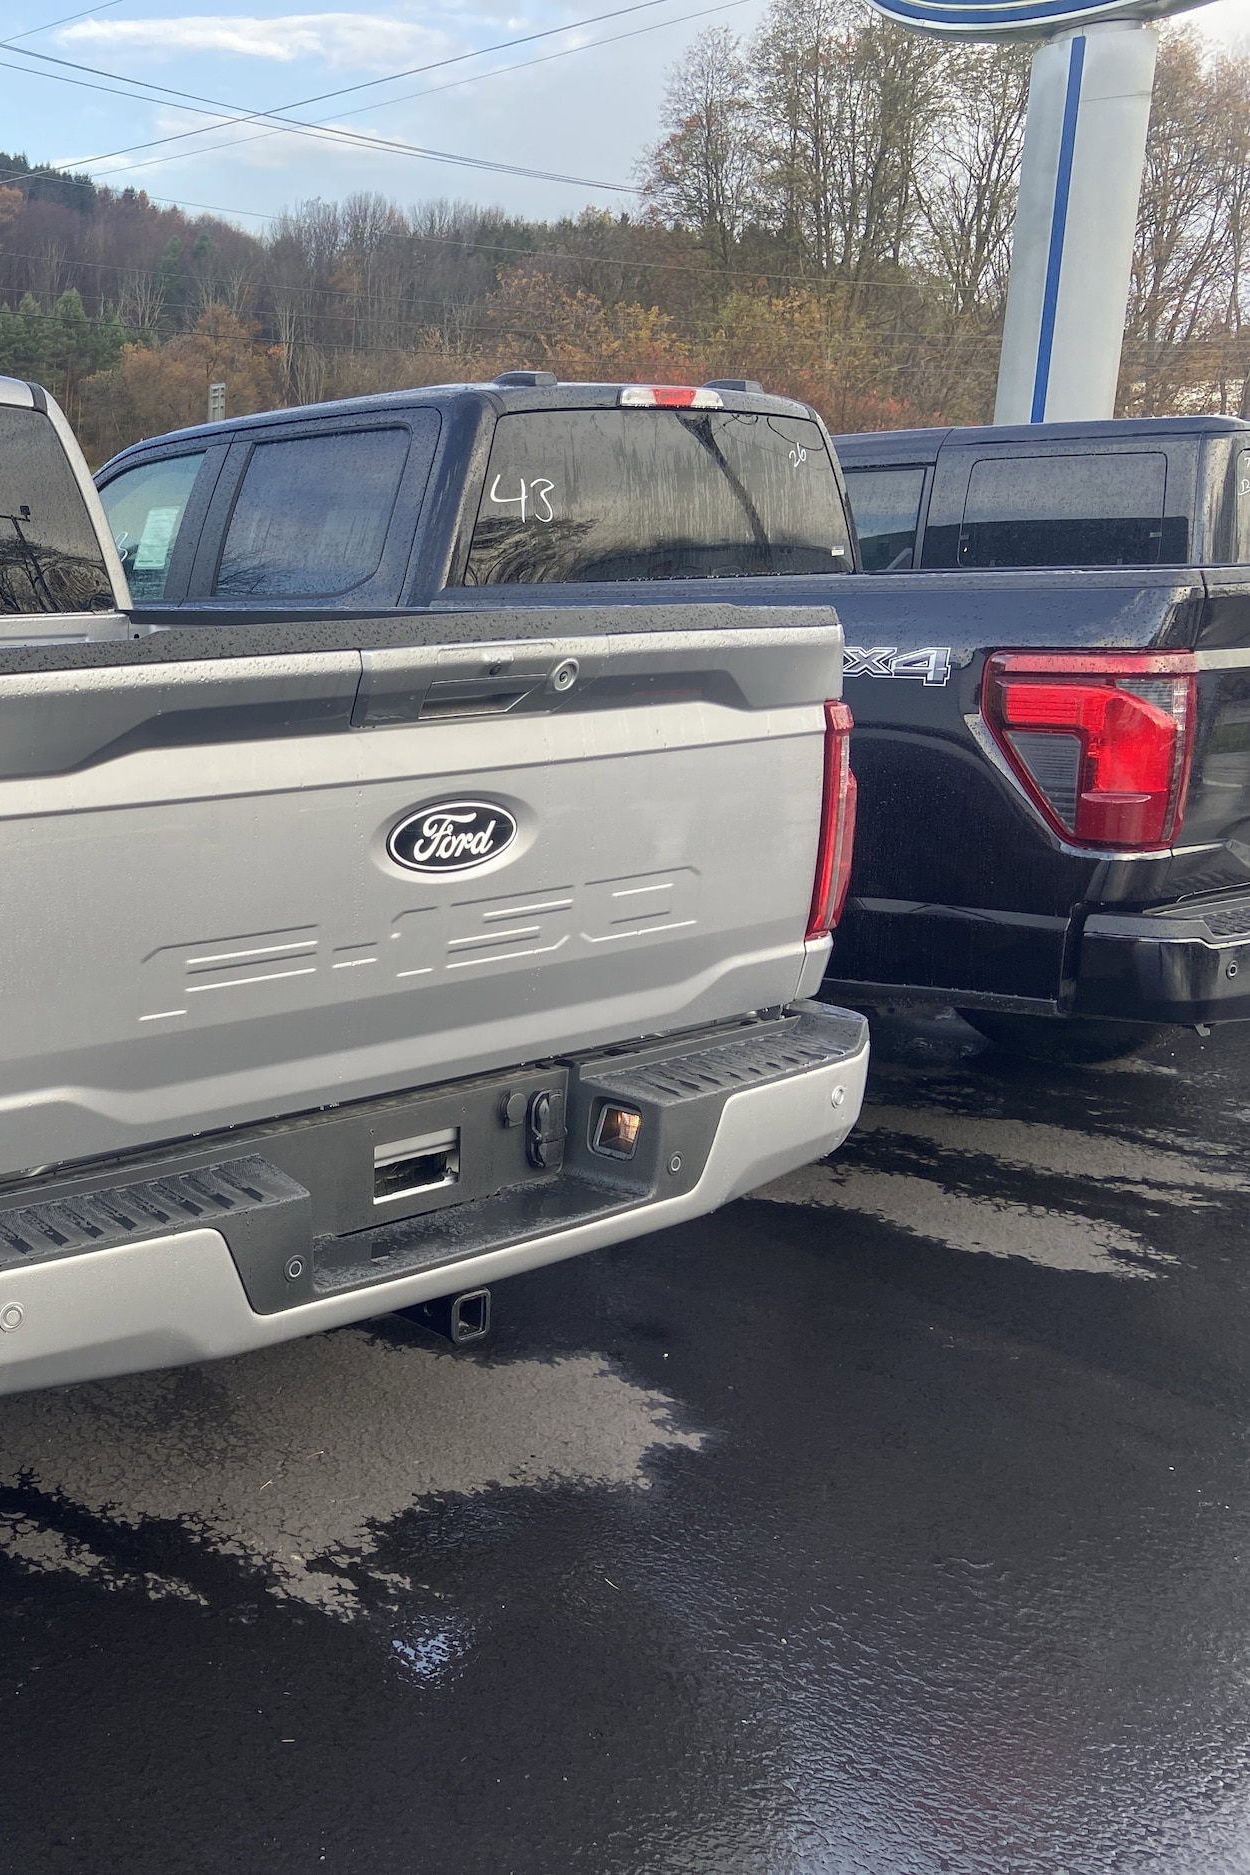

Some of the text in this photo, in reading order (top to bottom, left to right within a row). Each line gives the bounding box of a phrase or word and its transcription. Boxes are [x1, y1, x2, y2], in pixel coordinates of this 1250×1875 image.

[788, 442, 807, 468] 26
[490, 474, 555, 523] 43
[843, 646, 951, 686] X4
[413, 812, 497, 862] Ford
[137, 865, 703, 1022] F-150
